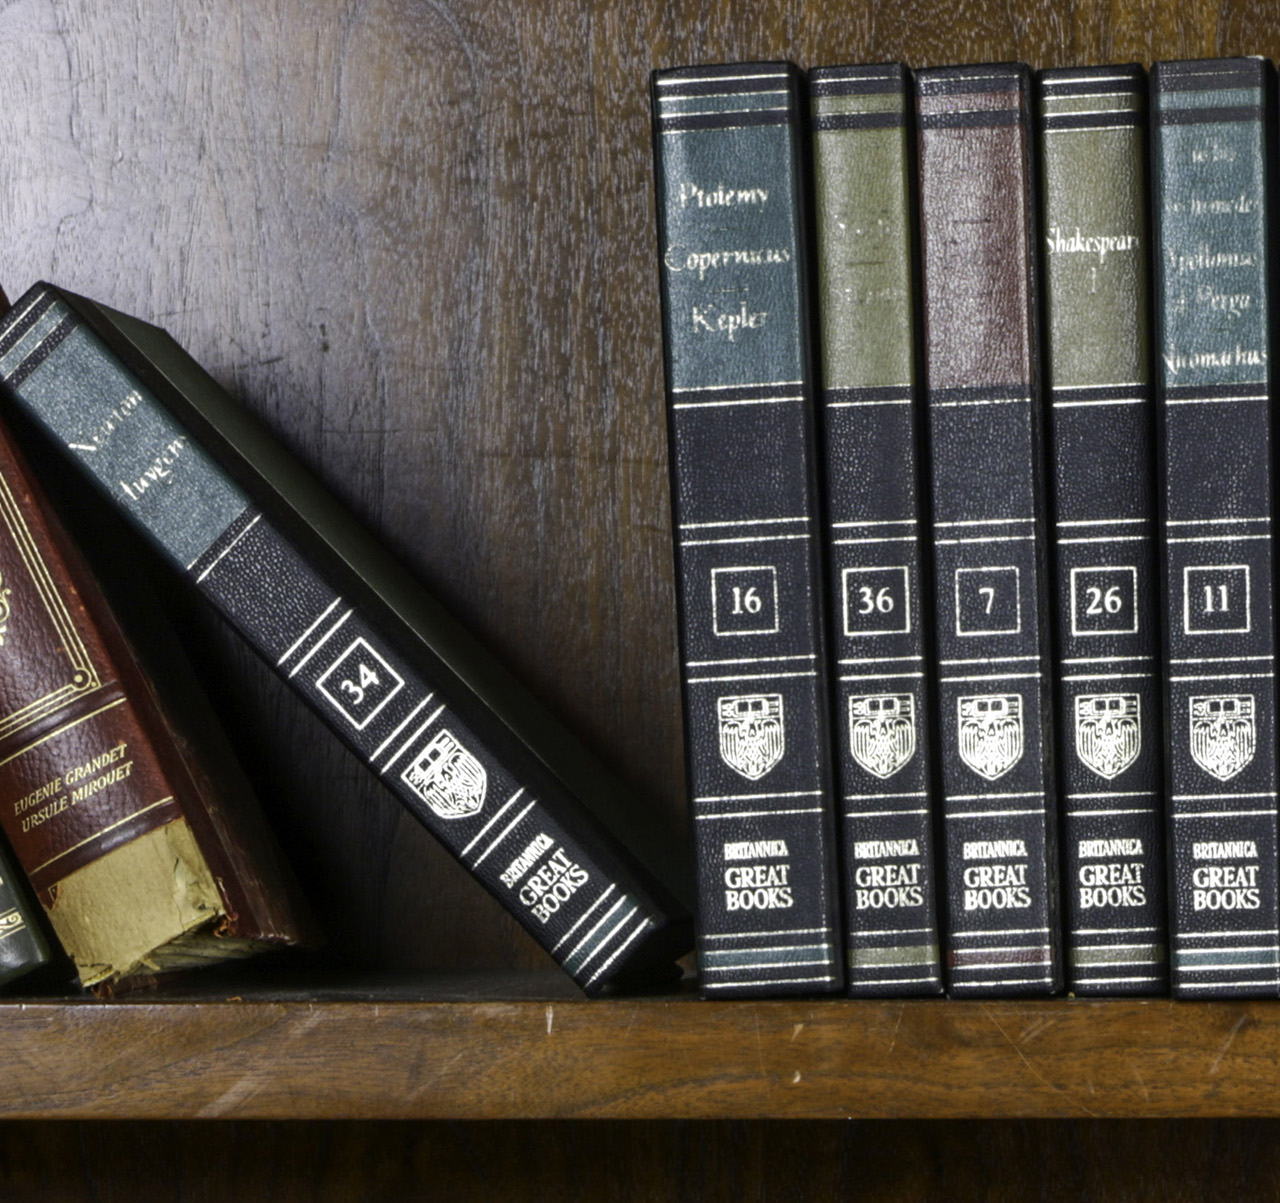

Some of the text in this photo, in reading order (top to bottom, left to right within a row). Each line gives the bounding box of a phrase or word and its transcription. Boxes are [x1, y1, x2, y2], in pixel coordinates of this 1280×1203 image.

[732, 586, 762, 614] 16
[1086, 586, 1122, 614] 26
[1203, 585, 1229, 612] 11
[340, 663, 380, 704] 34
[14, 743, 127, 816] EUGENIE GRANDET
[22, 761, 133, 832] URSULE MIROUET
[500, 832, 554, 889] BRITANNICA
[724, 840, 789, 859] BRITANNICA
[520, 847, 571, 909] GREAT
[725, 865, 790, 888] GREAT
[532, 864, 589, 924] BOOKS
[726, 887, 793, 911] BOOKS
